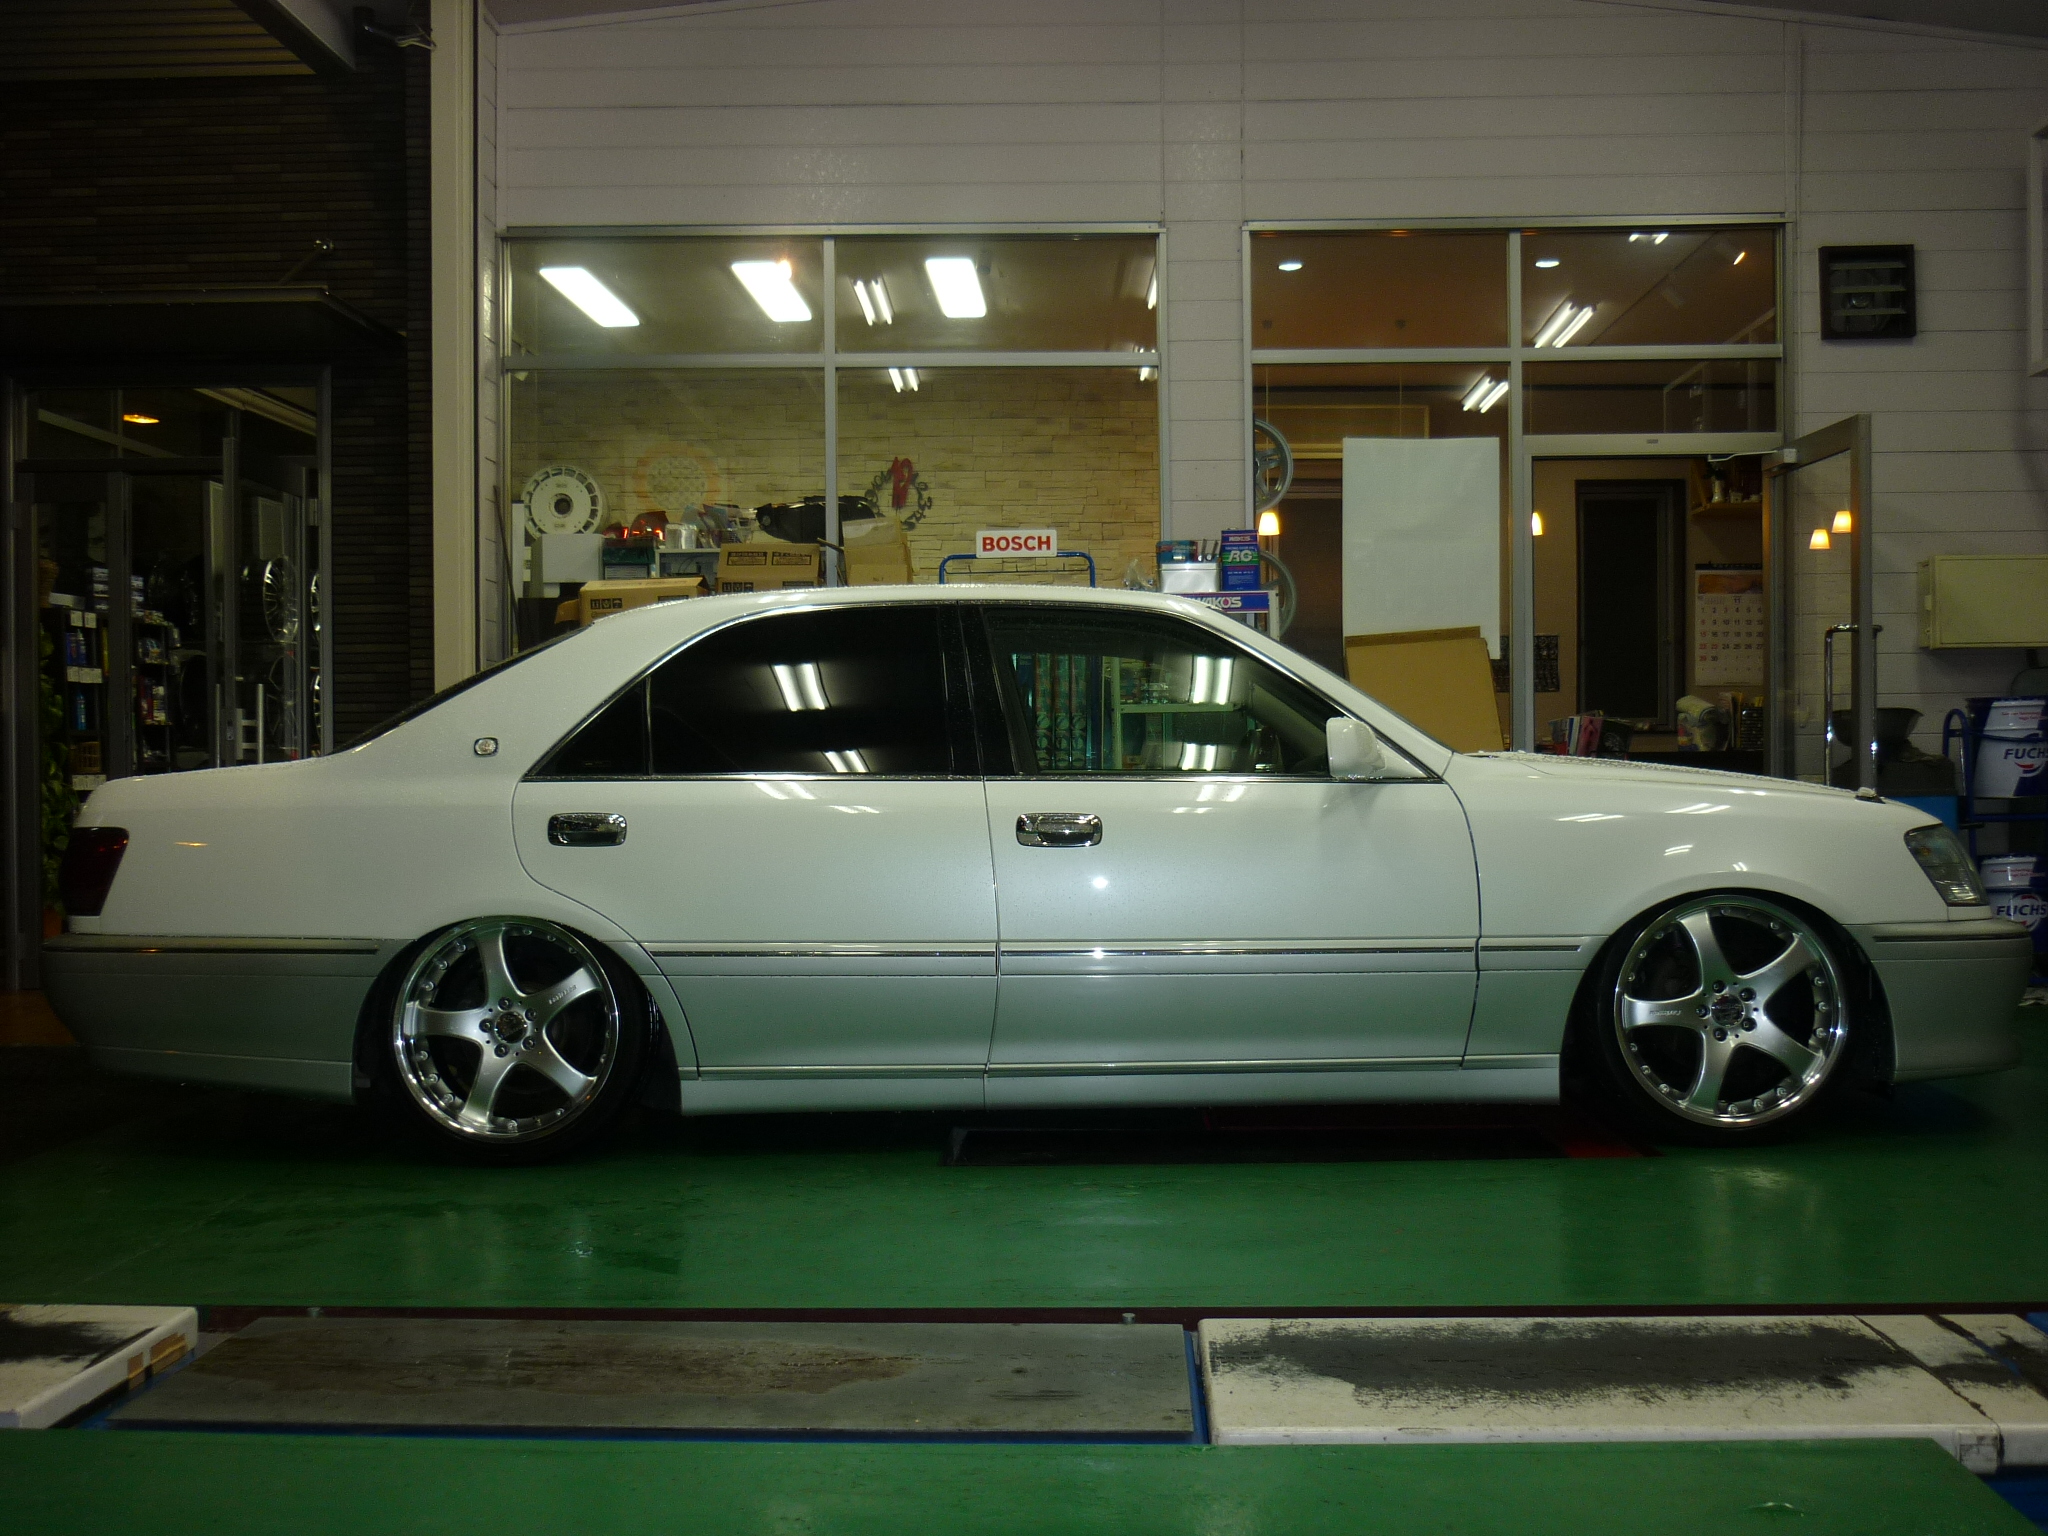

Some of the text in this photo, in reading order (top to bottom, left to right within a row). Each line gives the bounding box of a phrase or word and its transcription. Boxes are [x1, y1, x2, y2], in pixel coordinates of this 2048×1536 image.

[982, 535, 1051, 552] BOSCH
[1228, 549, 1253, 562] RG
[1996, 904, 2047, 917] FUCHS
